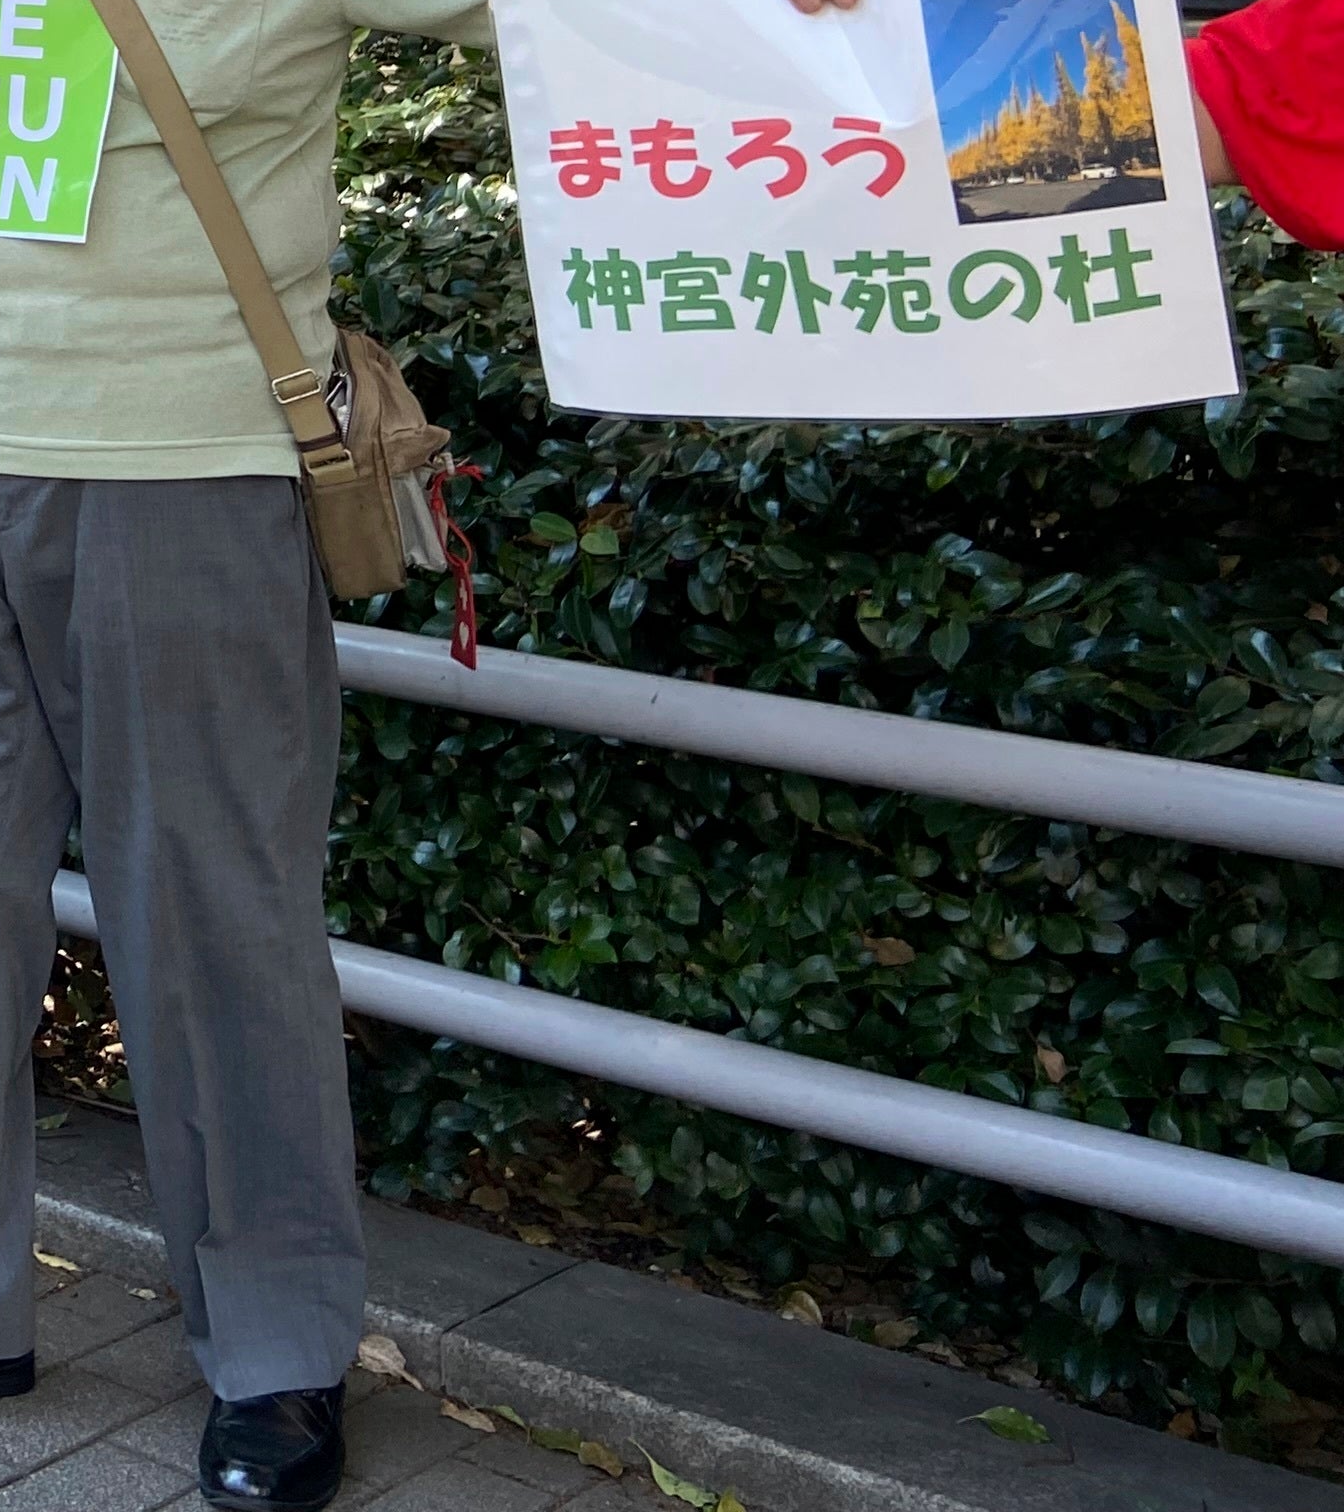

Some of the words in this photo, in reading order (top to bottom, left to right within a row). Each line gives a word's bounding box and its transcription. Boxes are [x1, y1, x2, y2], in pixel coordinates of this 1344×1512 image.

[549, 117, 906, 199] まもろう
[562, 227, 1162, 334] 神宮外苑の杜
